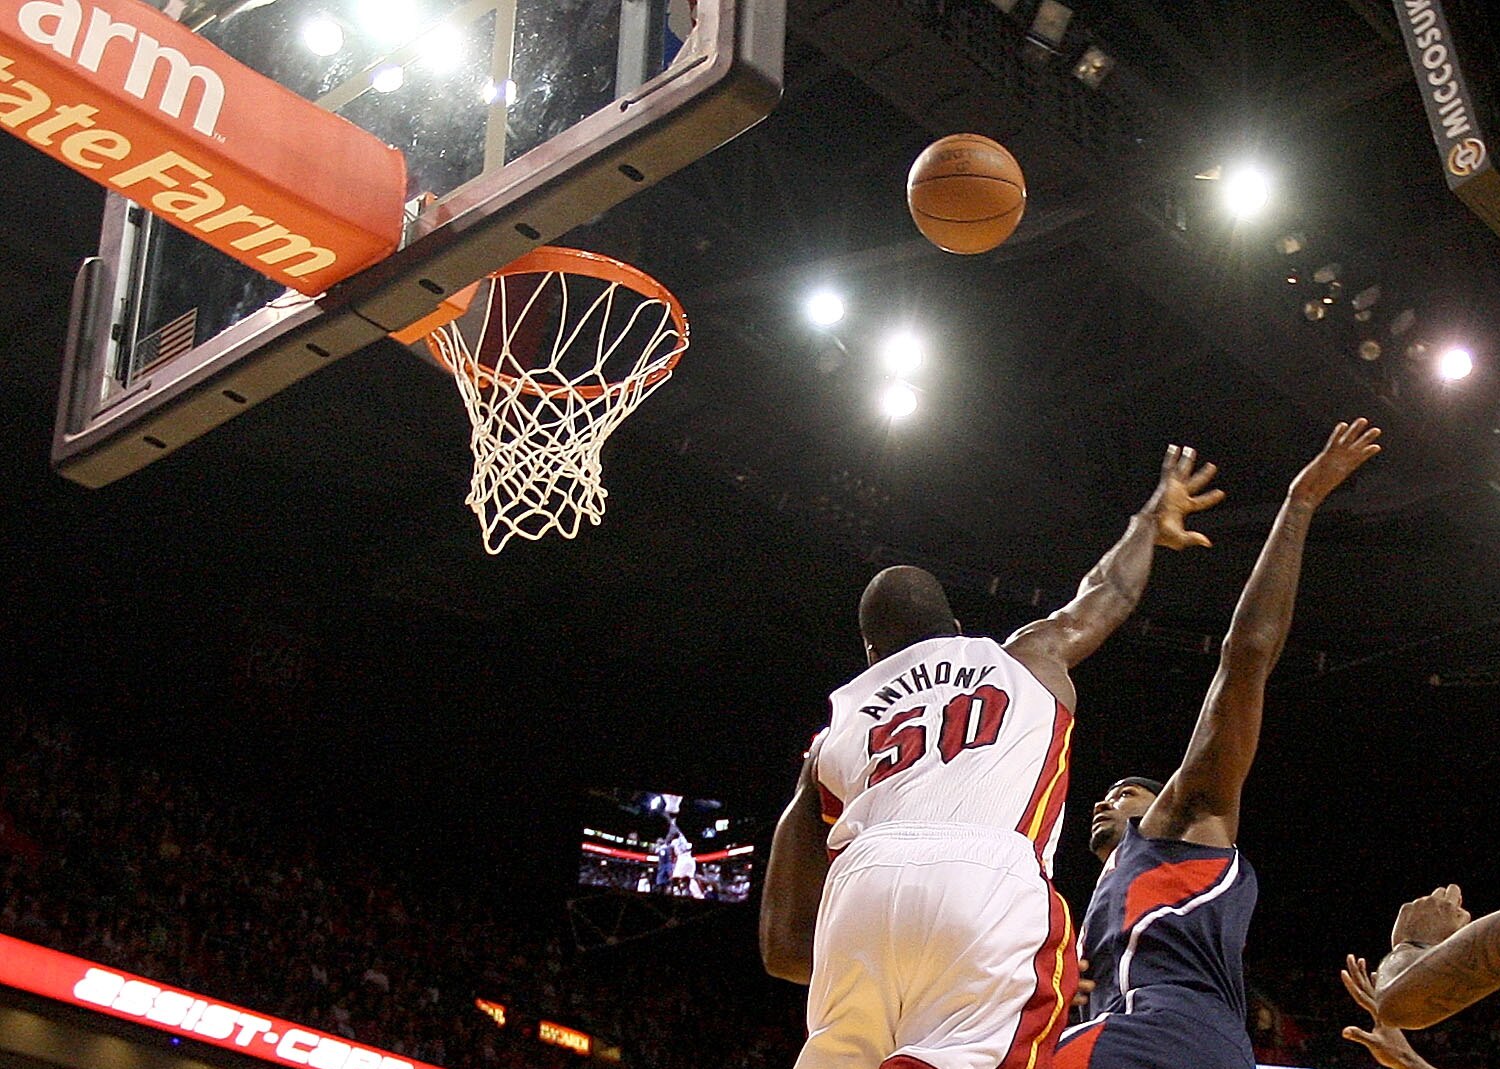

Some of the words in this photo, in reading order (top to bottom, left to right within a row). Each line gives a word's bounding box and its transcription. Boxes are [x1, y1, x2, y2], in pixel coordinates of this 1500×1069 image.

[109, 150, 337, 278] Farm
[859, 661, 997, 721] ANTHONY
[867, 684, 1010, 789] 50
